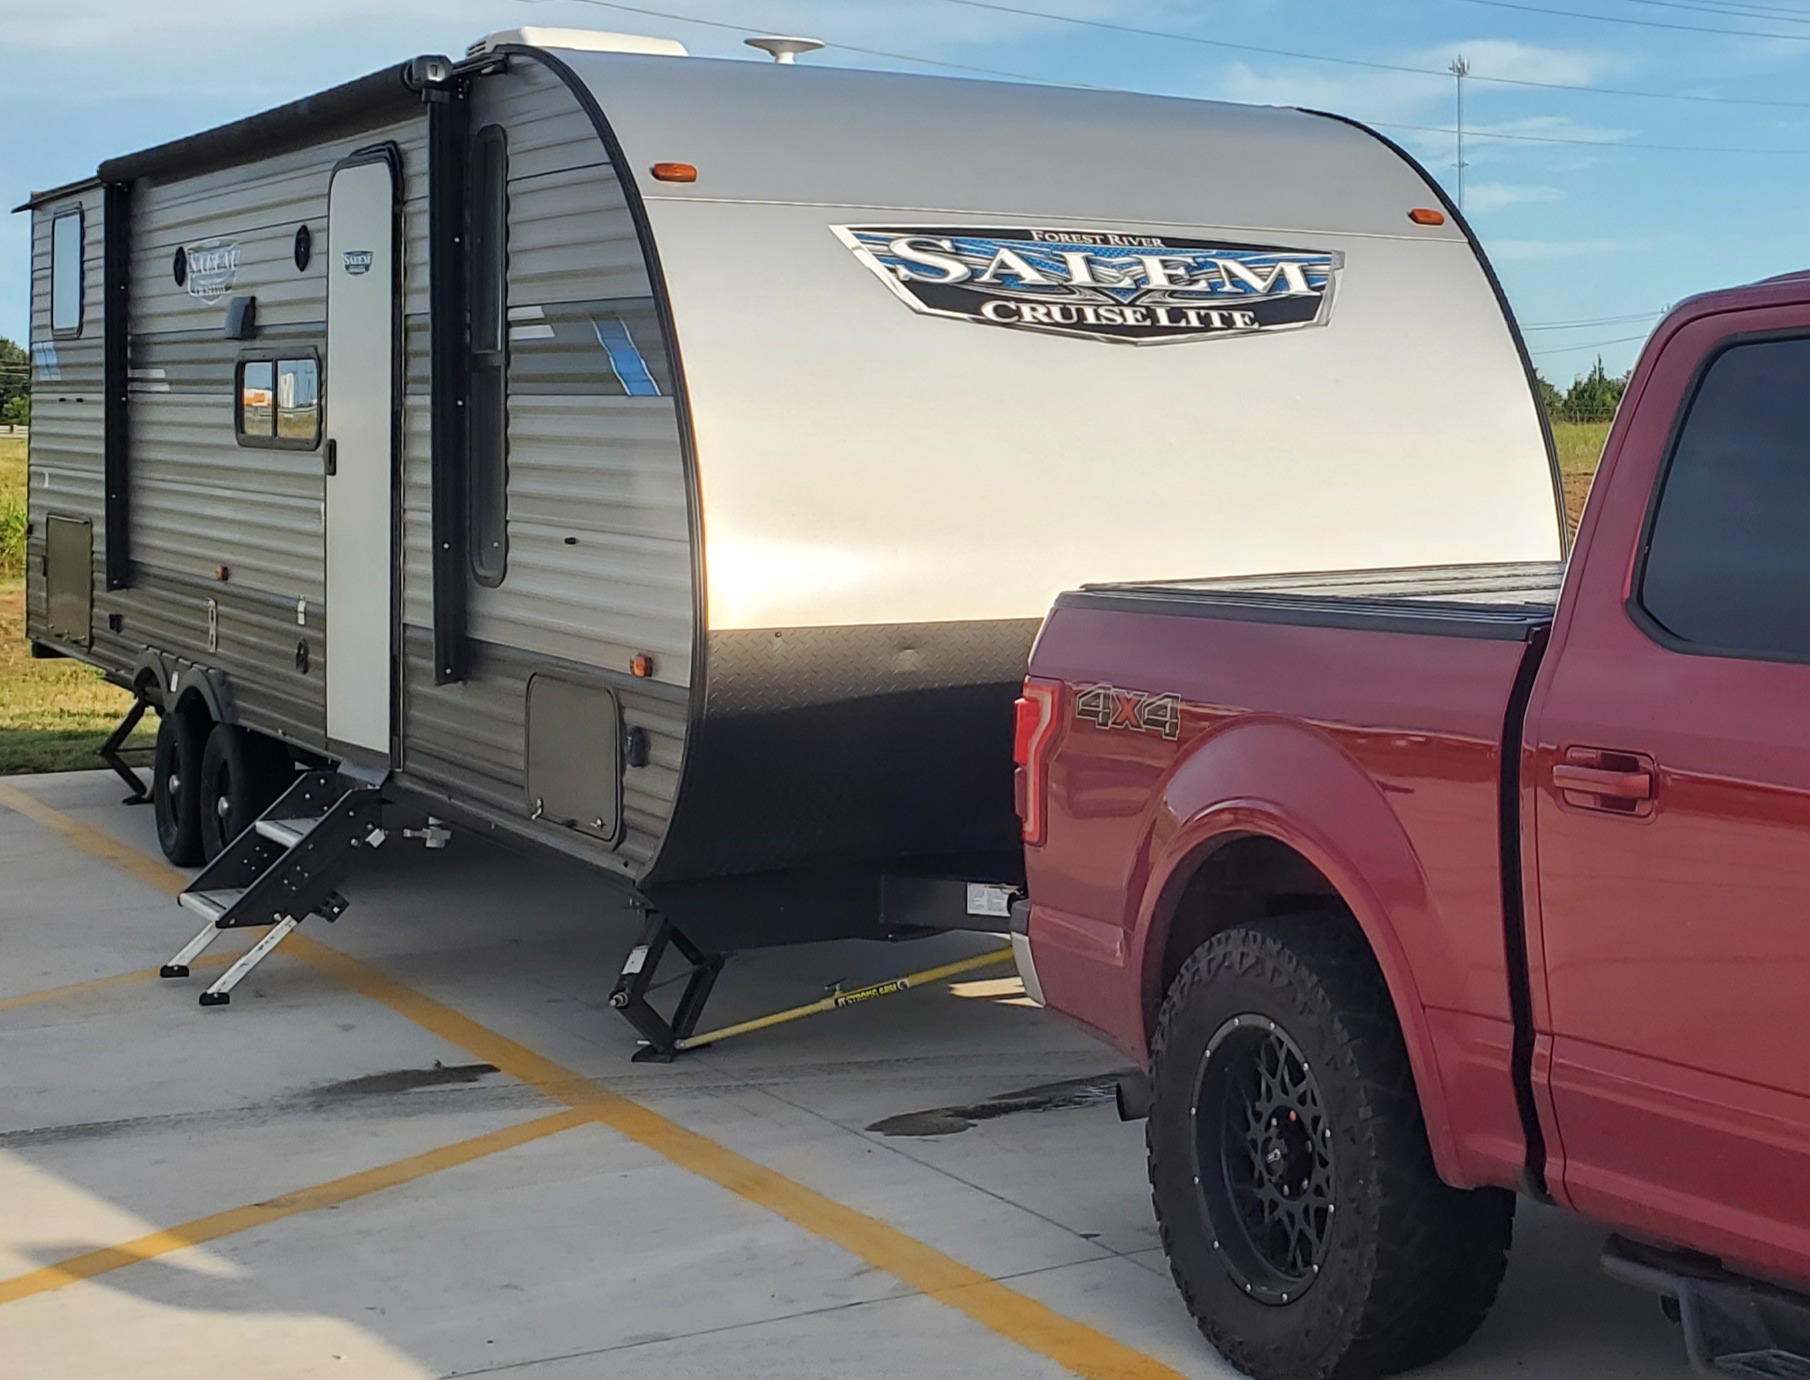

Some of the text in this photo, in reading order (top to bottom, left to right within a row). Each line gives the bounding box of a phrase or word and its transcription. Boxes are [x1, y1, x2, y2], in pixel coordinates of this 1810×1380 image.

[1030, 230, 1166, 249] FOREST RIVER
[888, 237, 1321, 296] SALEM
